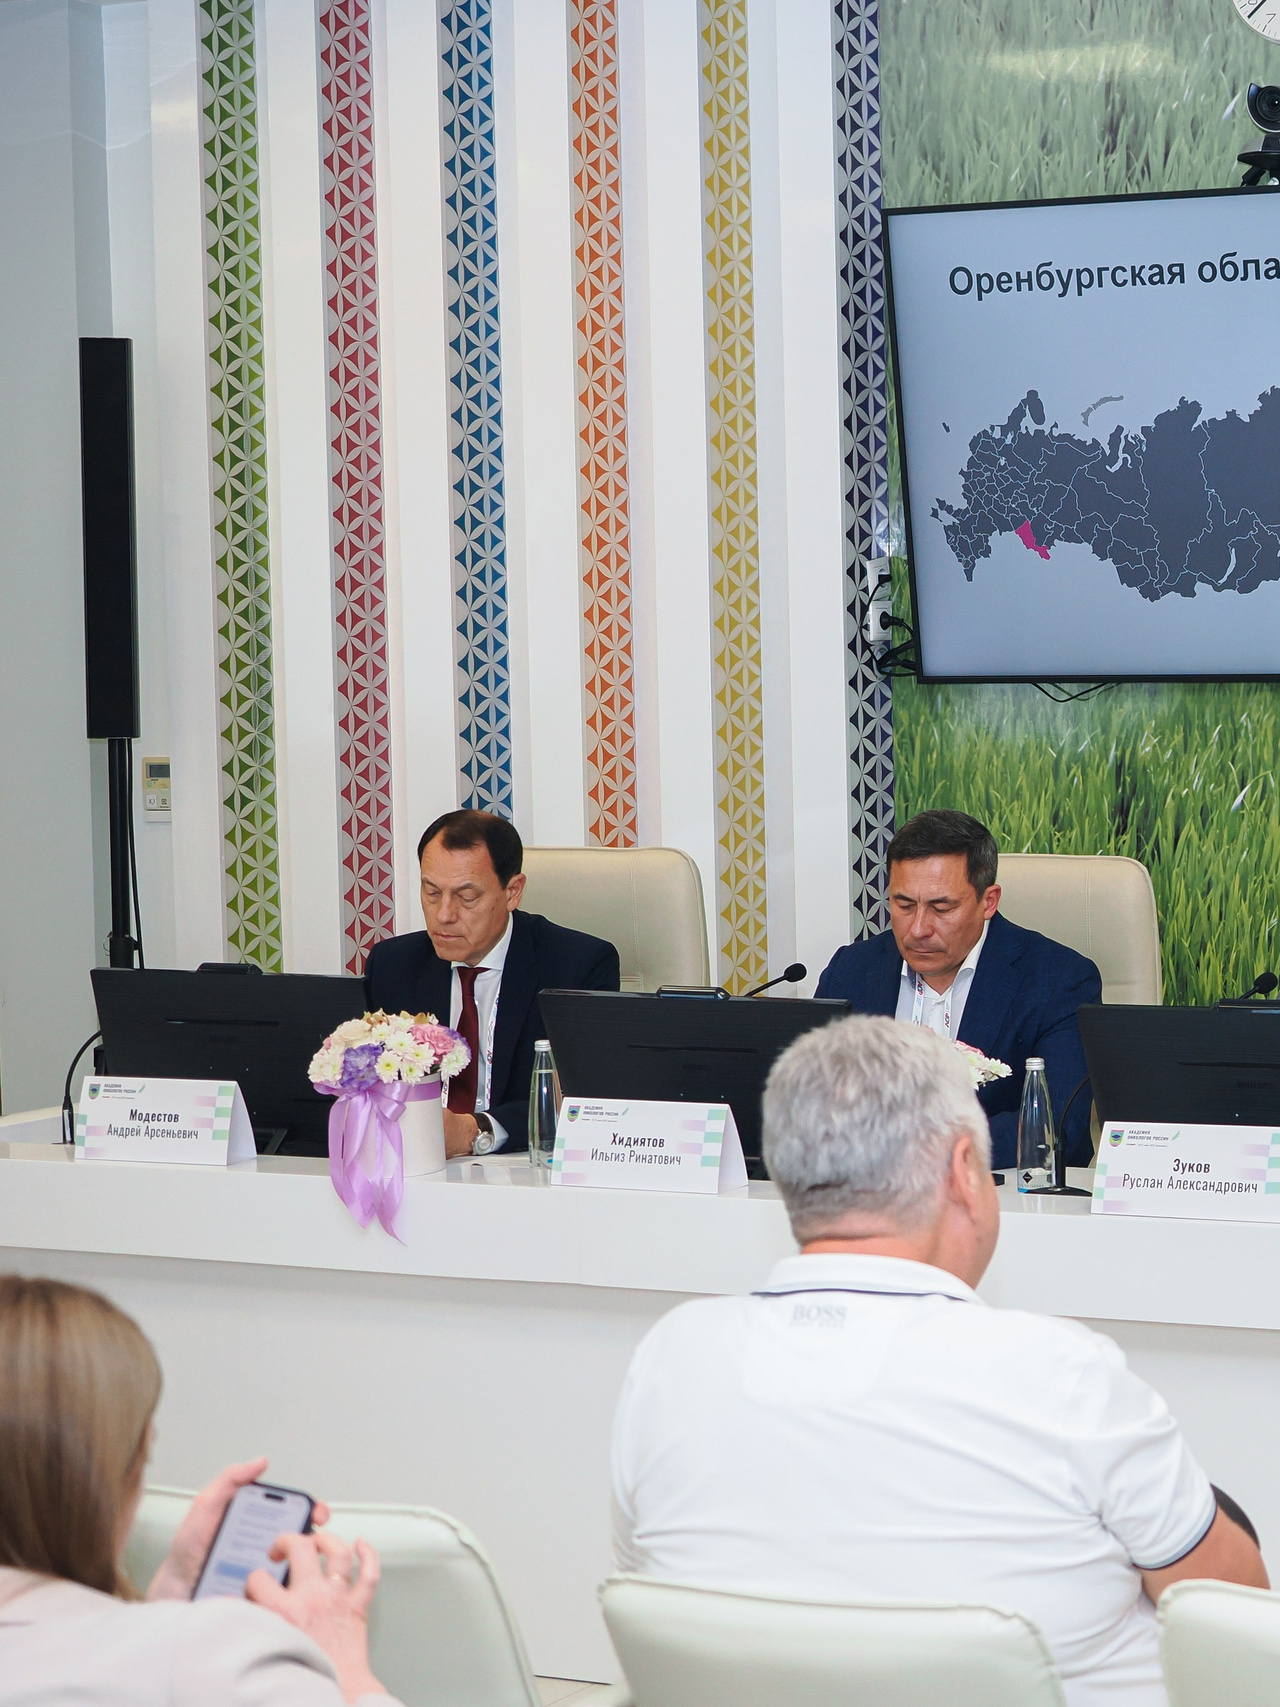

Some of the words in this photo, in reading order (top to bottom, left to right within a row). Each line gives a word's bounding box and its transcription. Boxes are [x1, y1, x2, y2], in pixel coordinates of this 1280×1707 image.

[949, 261, 1186, 301] Оренбургская
[129, 1109, 180, 1123] Модестов
[107, 1124, 141, 1139] Андрей
[144, 1126, 199, 1140] Арсеньевич
[611, 1132, 665, 1148] Хидиятов
[591, 1148, 625, 1163] Ильгиз
[629, 1150, 682, 1166] Ринатович
[1173, 1158, 1210, 1176] Зуков
[1122, 1174, 1163, 1190] Руслан
[1167, 1176, 1258, 1195] Александрович
[793, 1305, 847, 1321] BOSS
